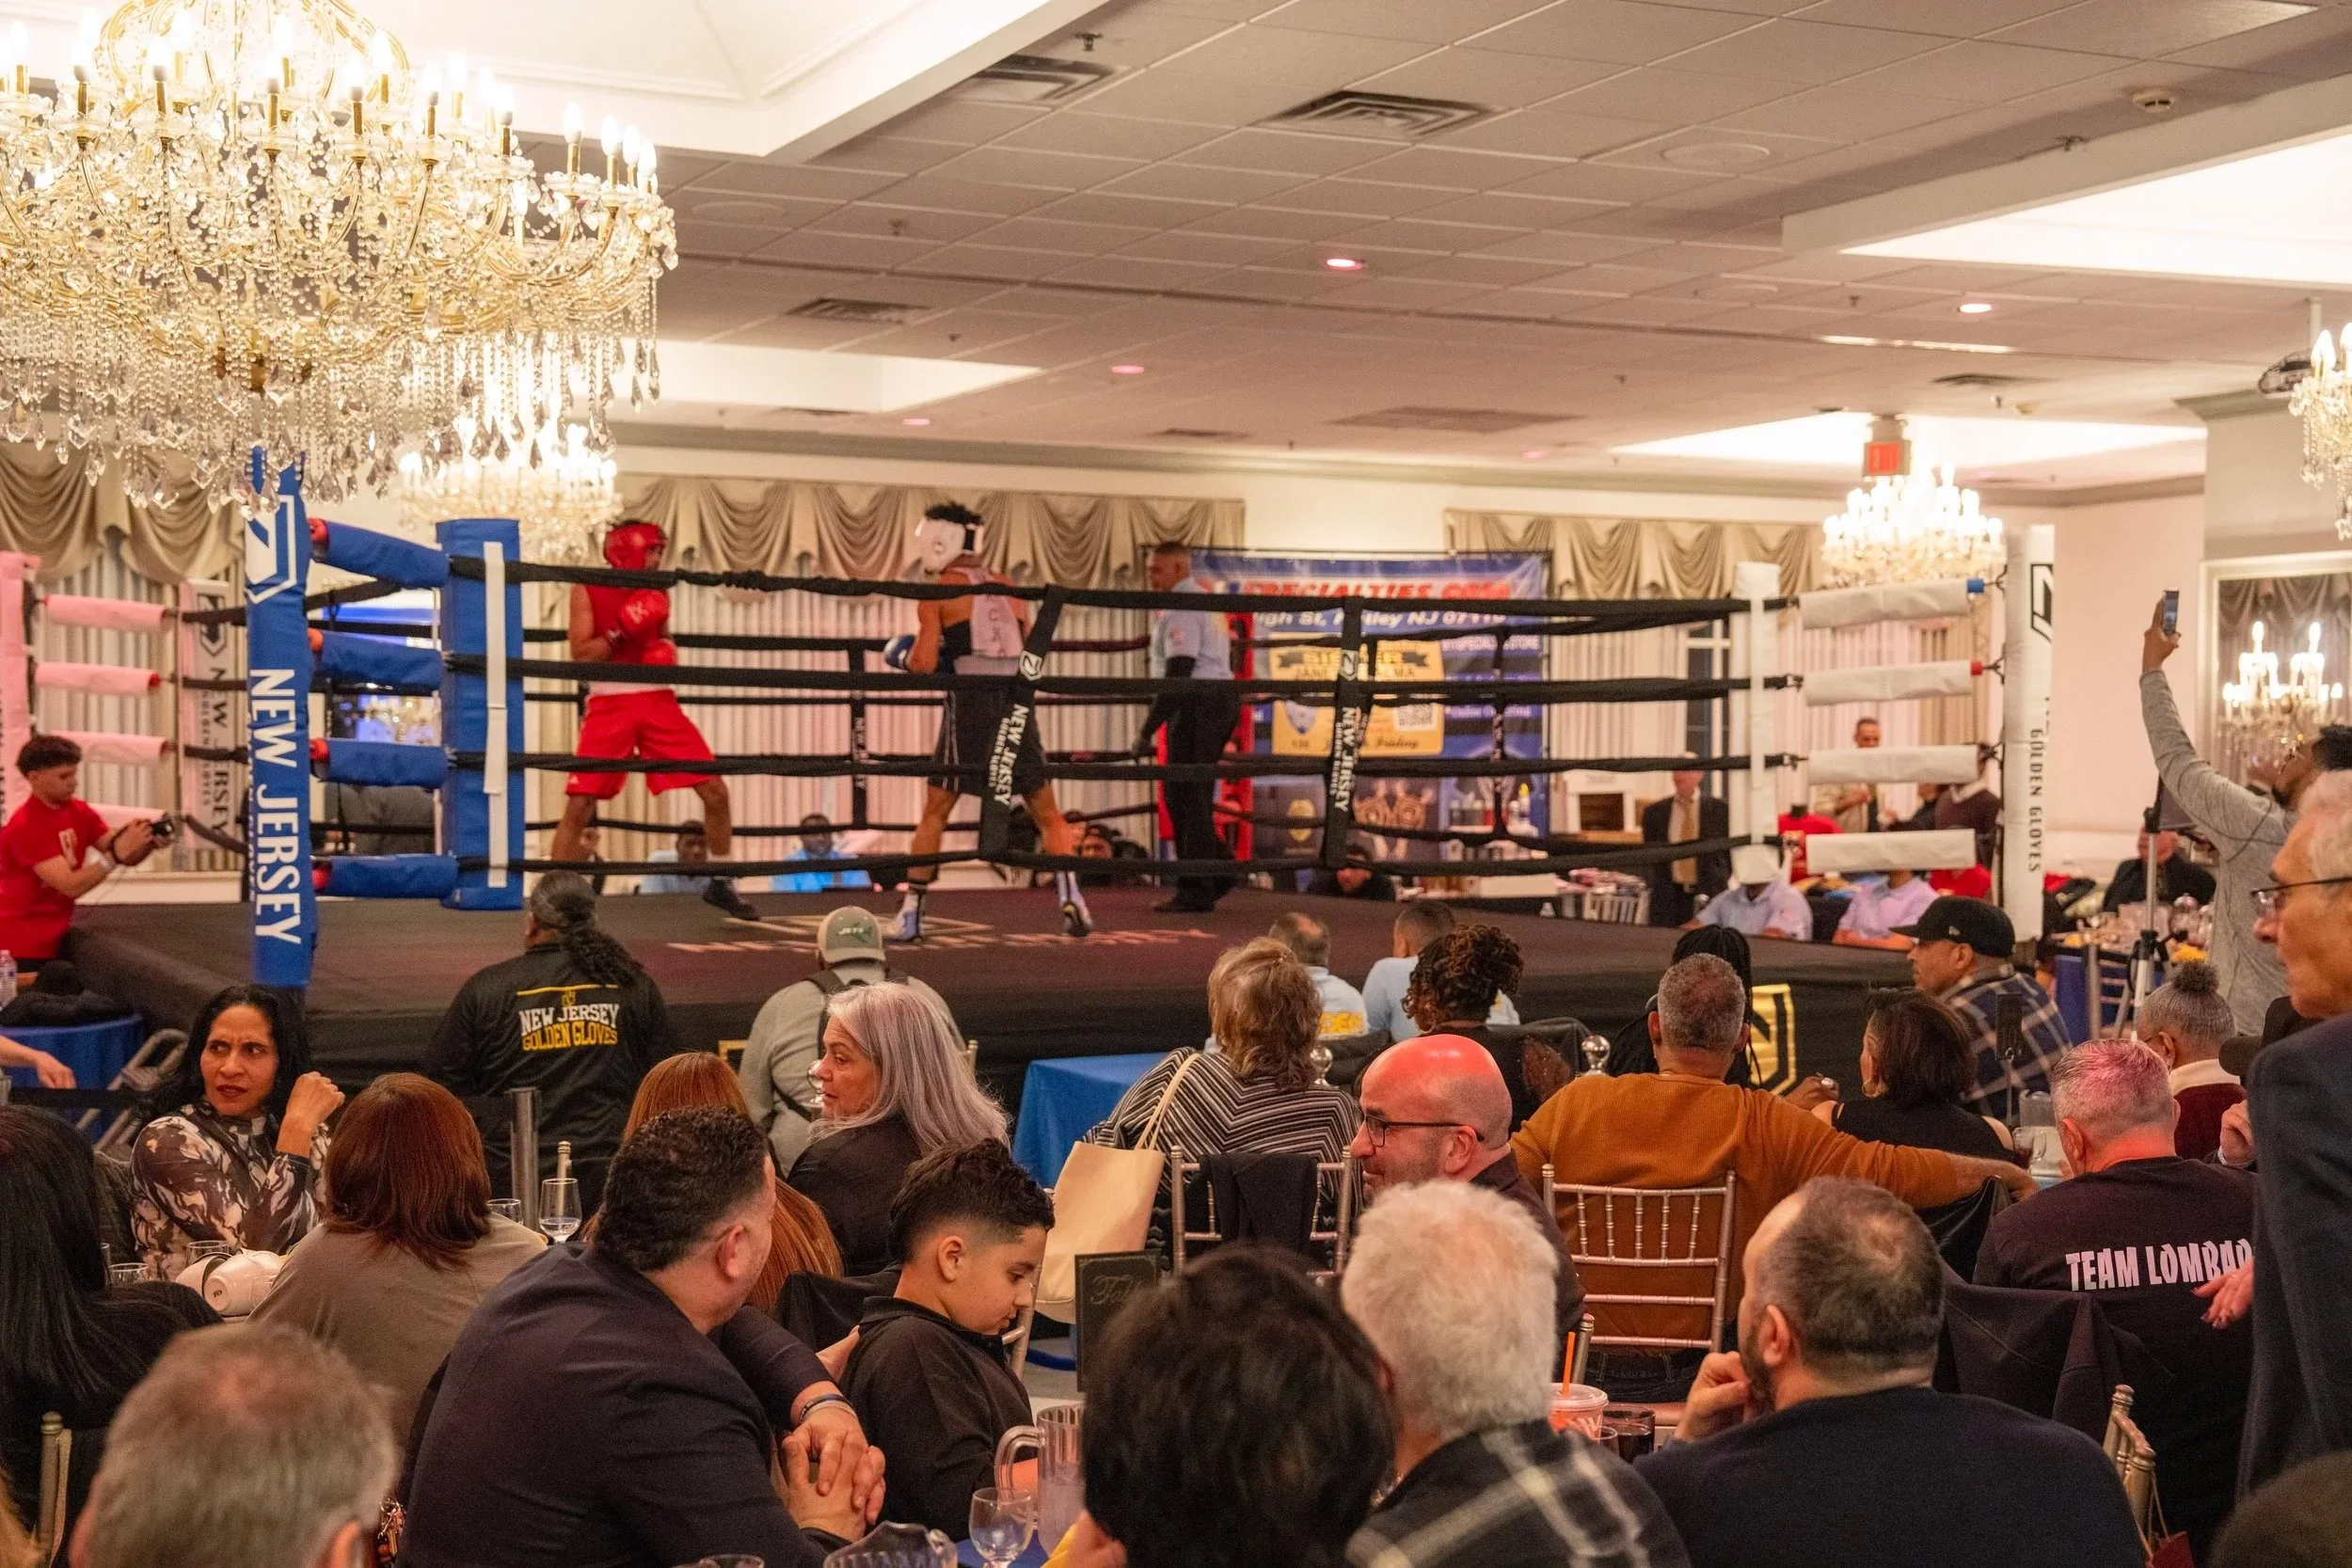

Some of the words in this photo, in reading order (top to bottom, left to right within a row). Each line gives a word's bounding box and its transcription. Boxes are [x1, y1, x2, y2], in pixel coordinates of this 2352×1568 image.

[1407, 611, 1439, 628] NJ
[210, 667, 229, 728] NW
[249, 669, 297, 768] NEW
[1007, 704, 1031, 746] NEW
[1341, 707, 1356, 748] NEW
[993, 746, 1018, 806] JERSEY
[1334, 750, 1356, 812] JERSEY
[2029, 728, 2044, 797] GOLDEN
[255, 784, 301, 944] JERSEY
[2028, 806, 2042, 873] GLOVES
[518, 1006, 555, 1037] NEW
[557, 1003, 621, 1029] JERSEY
[522, 1022, 572, 1052] GOLDEN
[572, 1021, 618, 1047] GLOVES
[2065, 1246, 2140, 1291] TEAM
